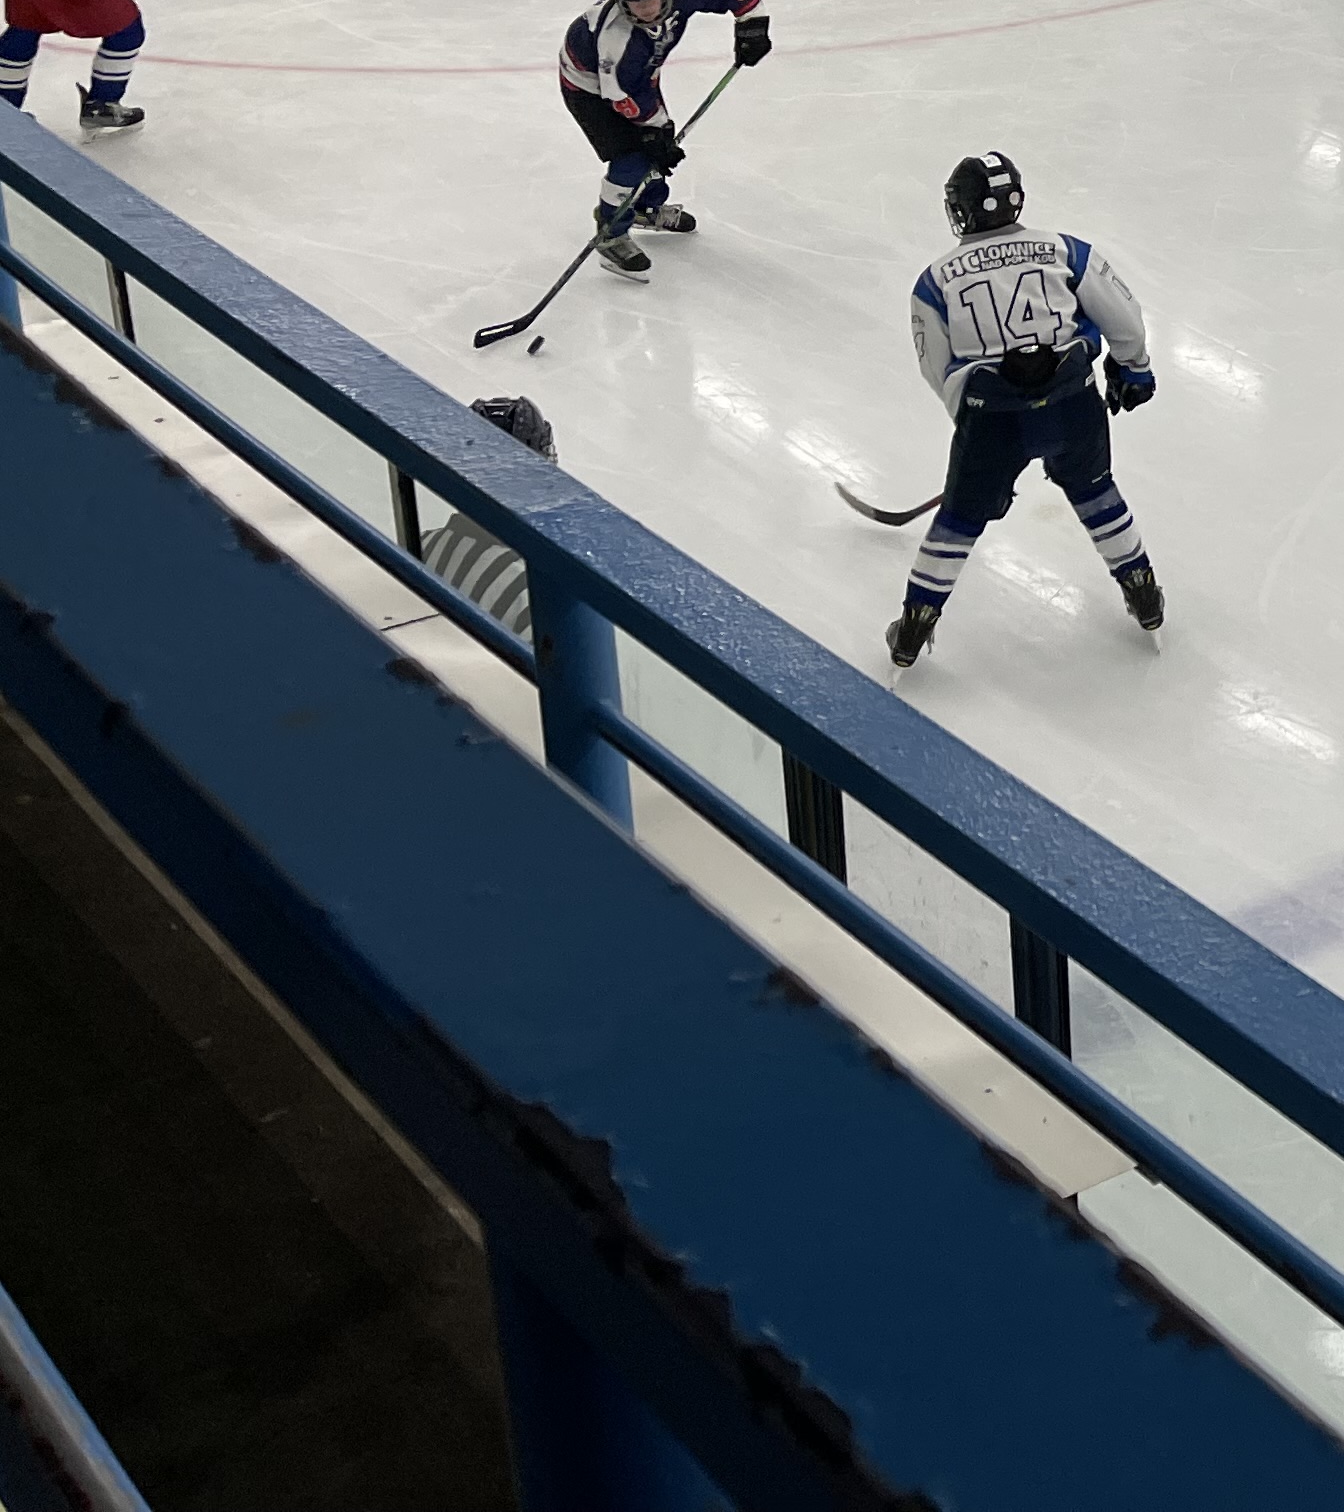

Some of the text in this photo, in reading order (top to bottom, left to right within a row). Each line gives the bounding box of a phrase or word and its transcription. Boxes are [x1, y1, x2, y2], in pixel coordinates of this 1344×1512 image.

[941, 241, 1056, 283] HC LOMNICE
[981, 258, 1003, 271] NAD
[959, 269, 1063, 358] 14
